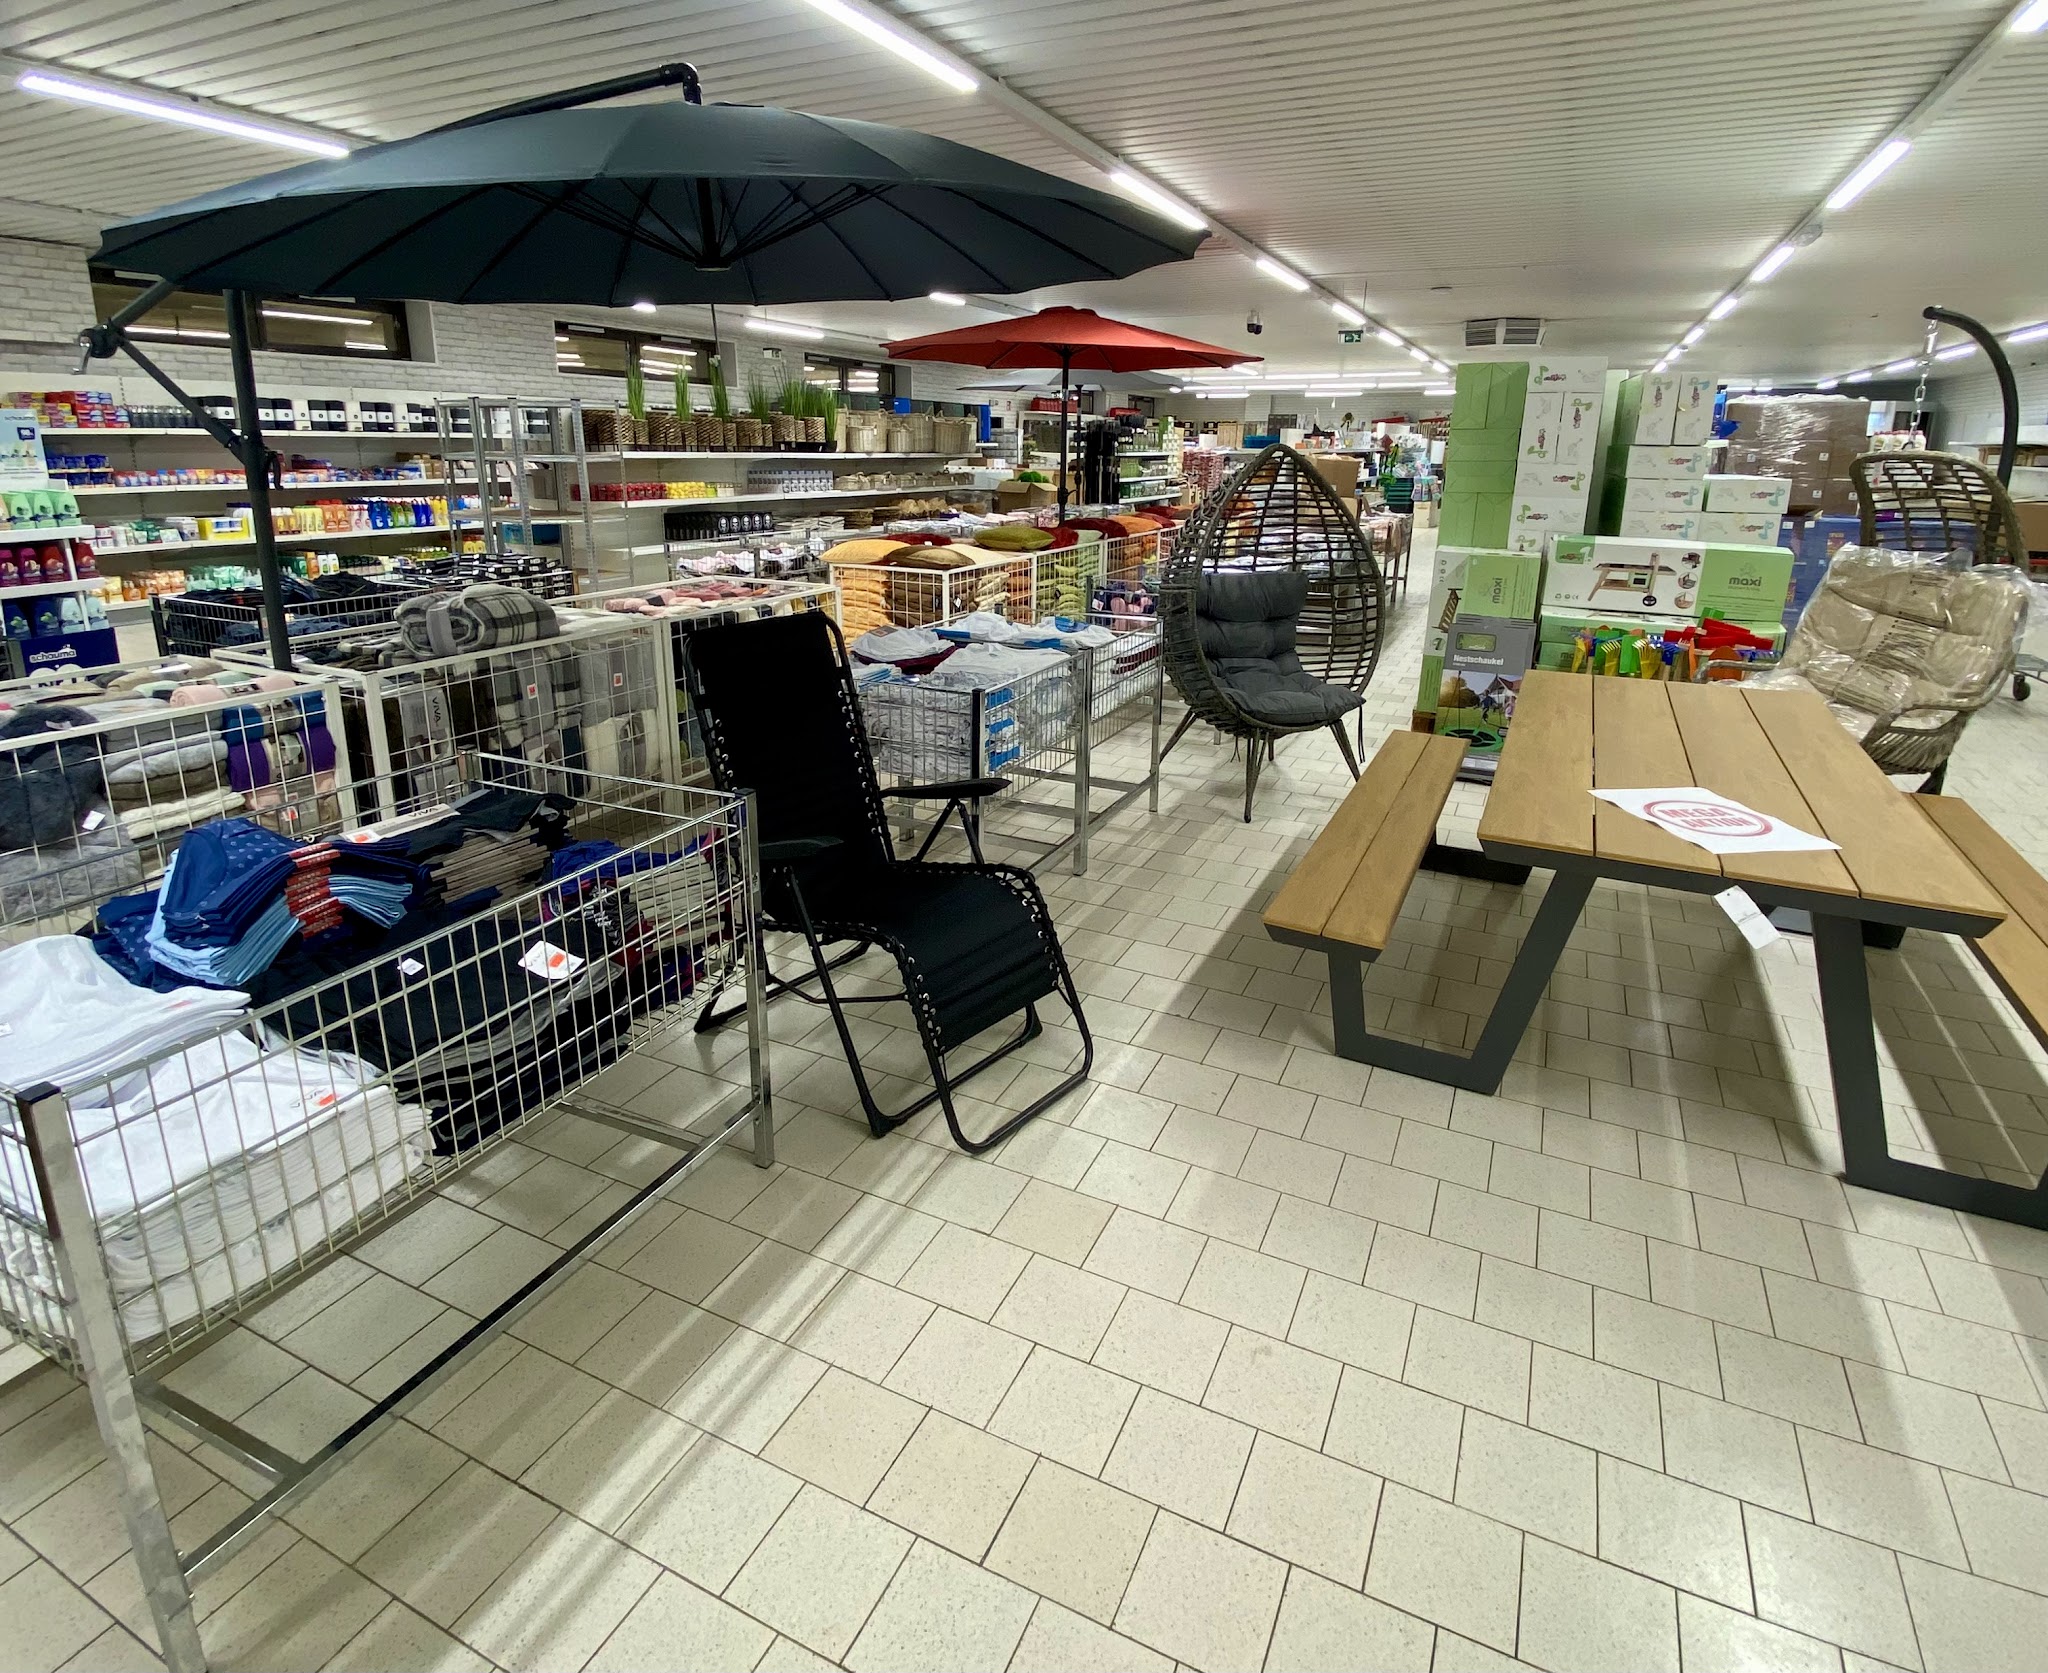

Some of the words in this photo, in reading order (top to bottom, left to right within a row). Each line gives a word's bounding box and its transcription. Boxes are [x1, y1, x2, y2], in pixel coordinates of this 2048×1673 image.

[1728, 576, 1762, 587] maxi
[1492, 577, 1503, 604] maxi
[30, 650, 75, 662] schauma
[1453, 654, 1504, 665] Nestschaukel
[408, 807, 438, 818] VIVA
[1658, 807, 1736, 818] MEGA
[1681, 817, 1759, 828] AKTION
